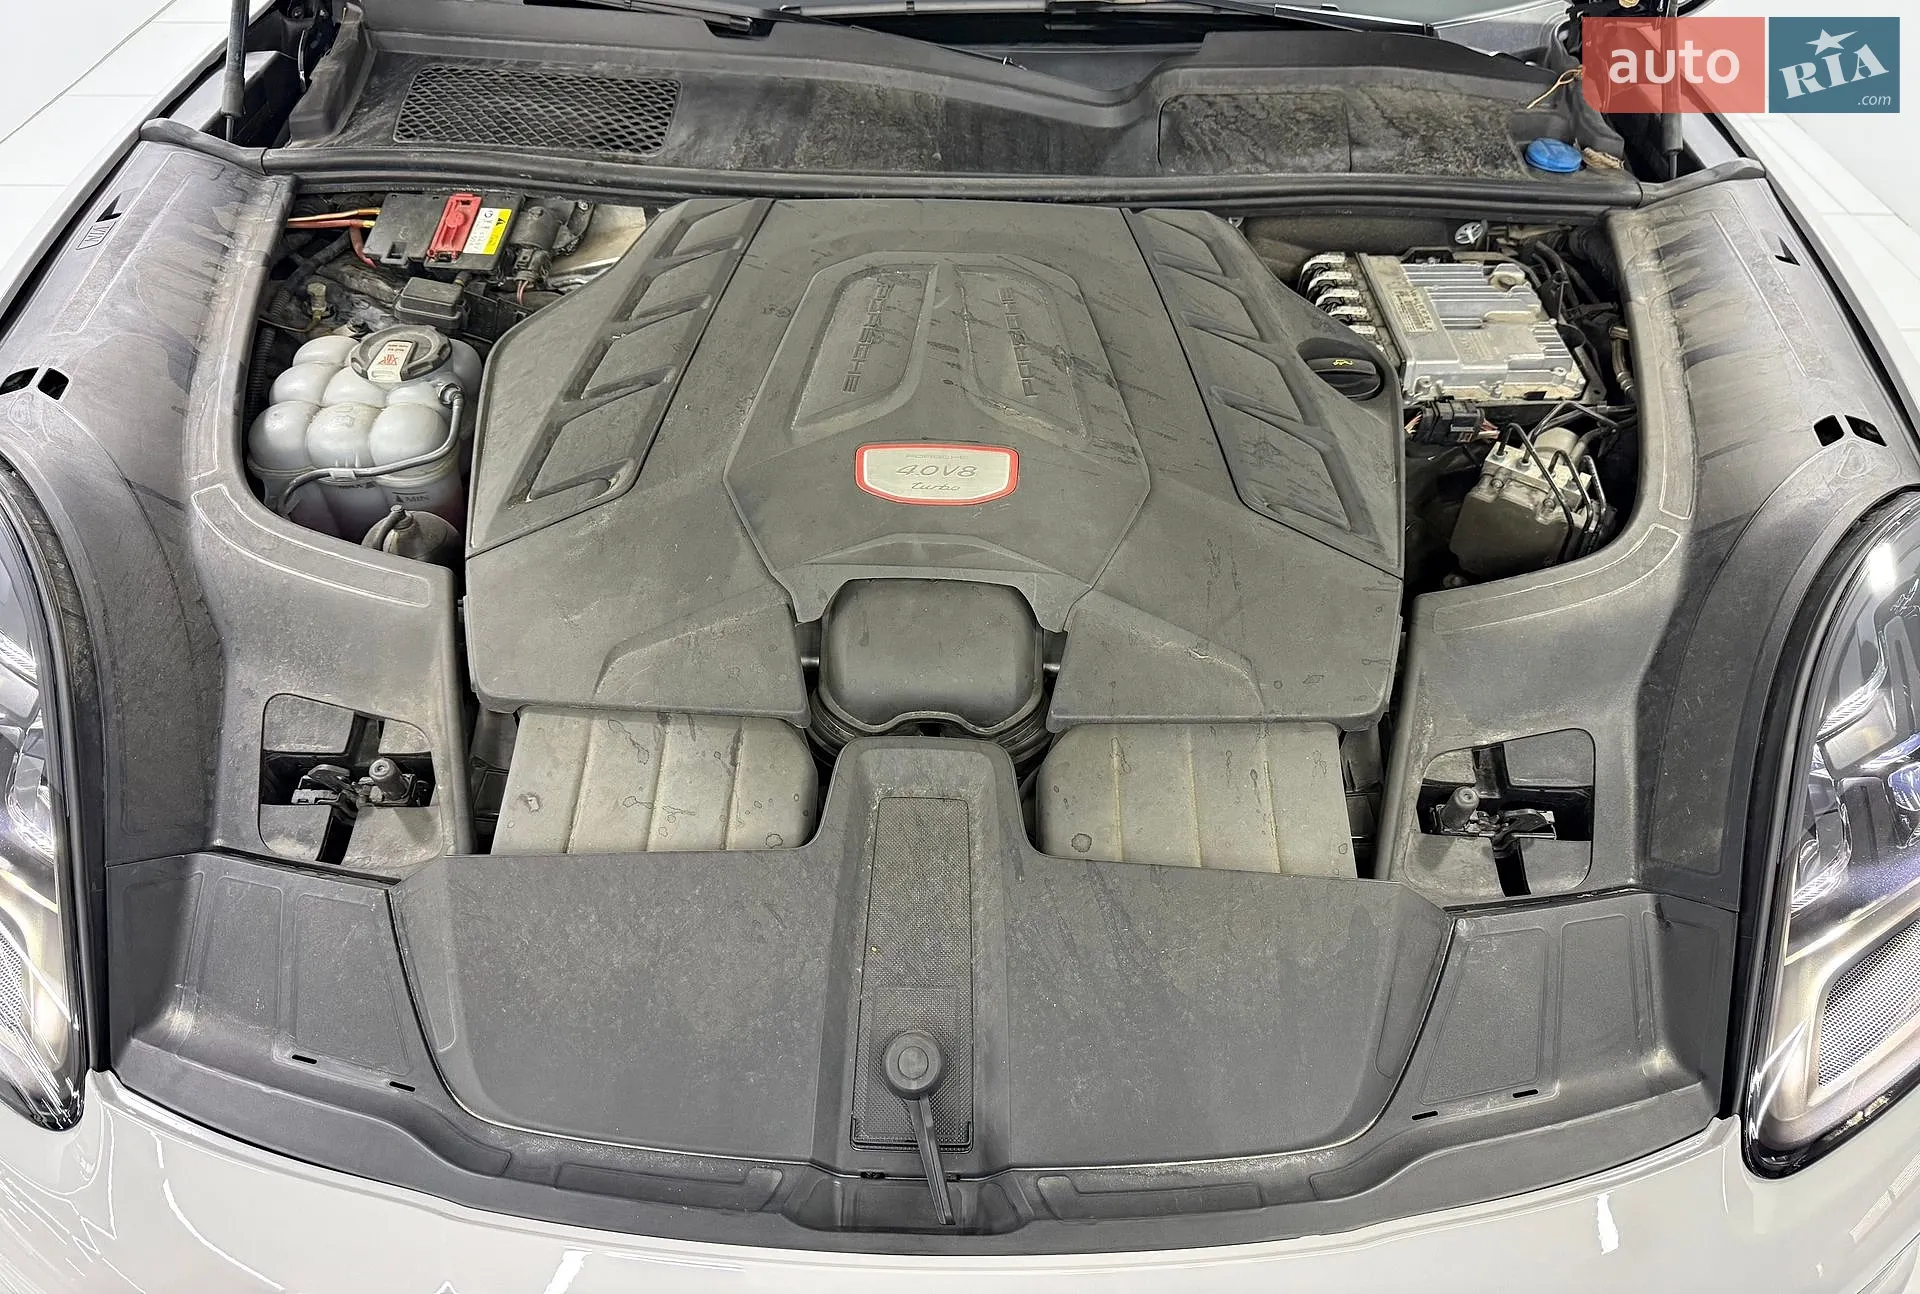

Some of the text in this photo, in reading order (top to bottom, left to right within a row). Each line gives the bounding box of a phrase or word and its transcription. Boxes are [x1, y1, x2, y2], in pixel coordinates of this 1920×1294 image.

[84, 225, 111, 242] VIN
[841, 281, 896, 394] PORSCHE
[995, 287, 1040, 397] PORSCHE
[911, 481, 961, 491] turbo
